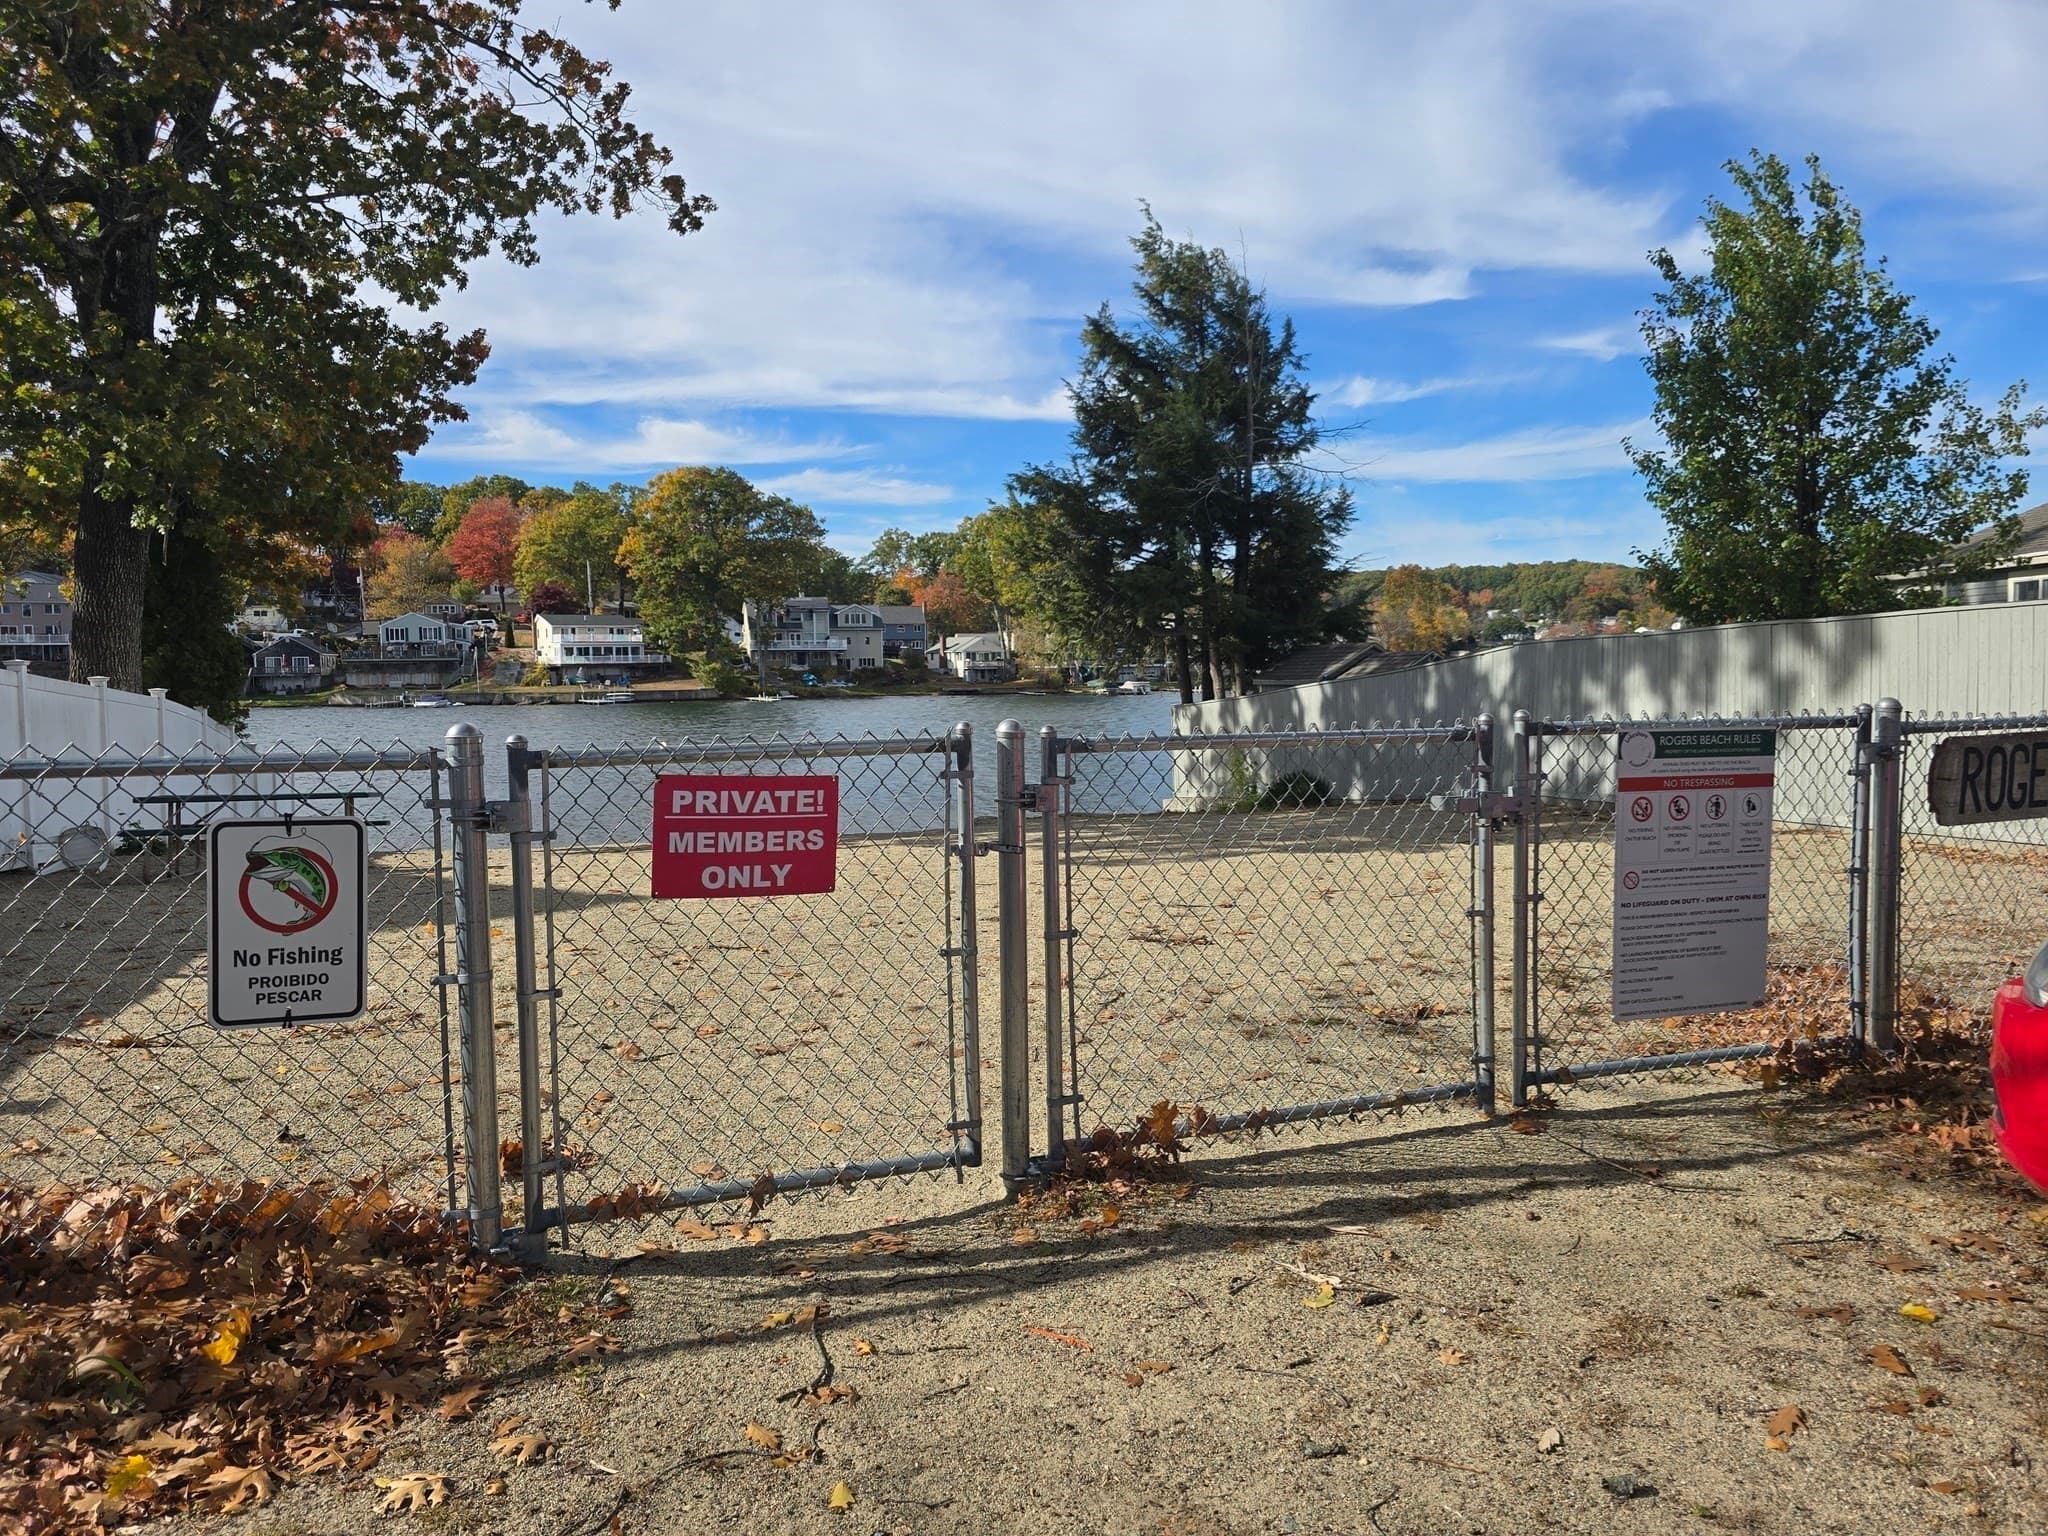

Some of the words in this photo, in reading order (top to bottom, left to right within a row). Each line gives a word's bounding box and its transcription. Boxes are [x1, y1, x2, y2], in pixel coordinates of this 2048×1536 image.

[1659, 735, 1697, 746] ROGERS
[1699, 734, 1731, 745] BEACH
[1733, 733, 1761, 744] RULES
[1663, 779, 1678, 788] NO
[1680, 777, 1735, 787] TRESPASSING
[672, 789, 825, 814] PRIVATE!
[669, 828, 825, 853] MEMBERS
[701, 864, 793, 889] ONLY
[1632, 899, 1670, 908] LIFEGUARD
[1682, 897, 1700, 905] DUTY
[233, 949, 261, 968] No
[268, 946, 344, 966] Fishing
[248, 972, 330, 989] PROIBIDO
[255, 989, 323, 1005] PESCAR
